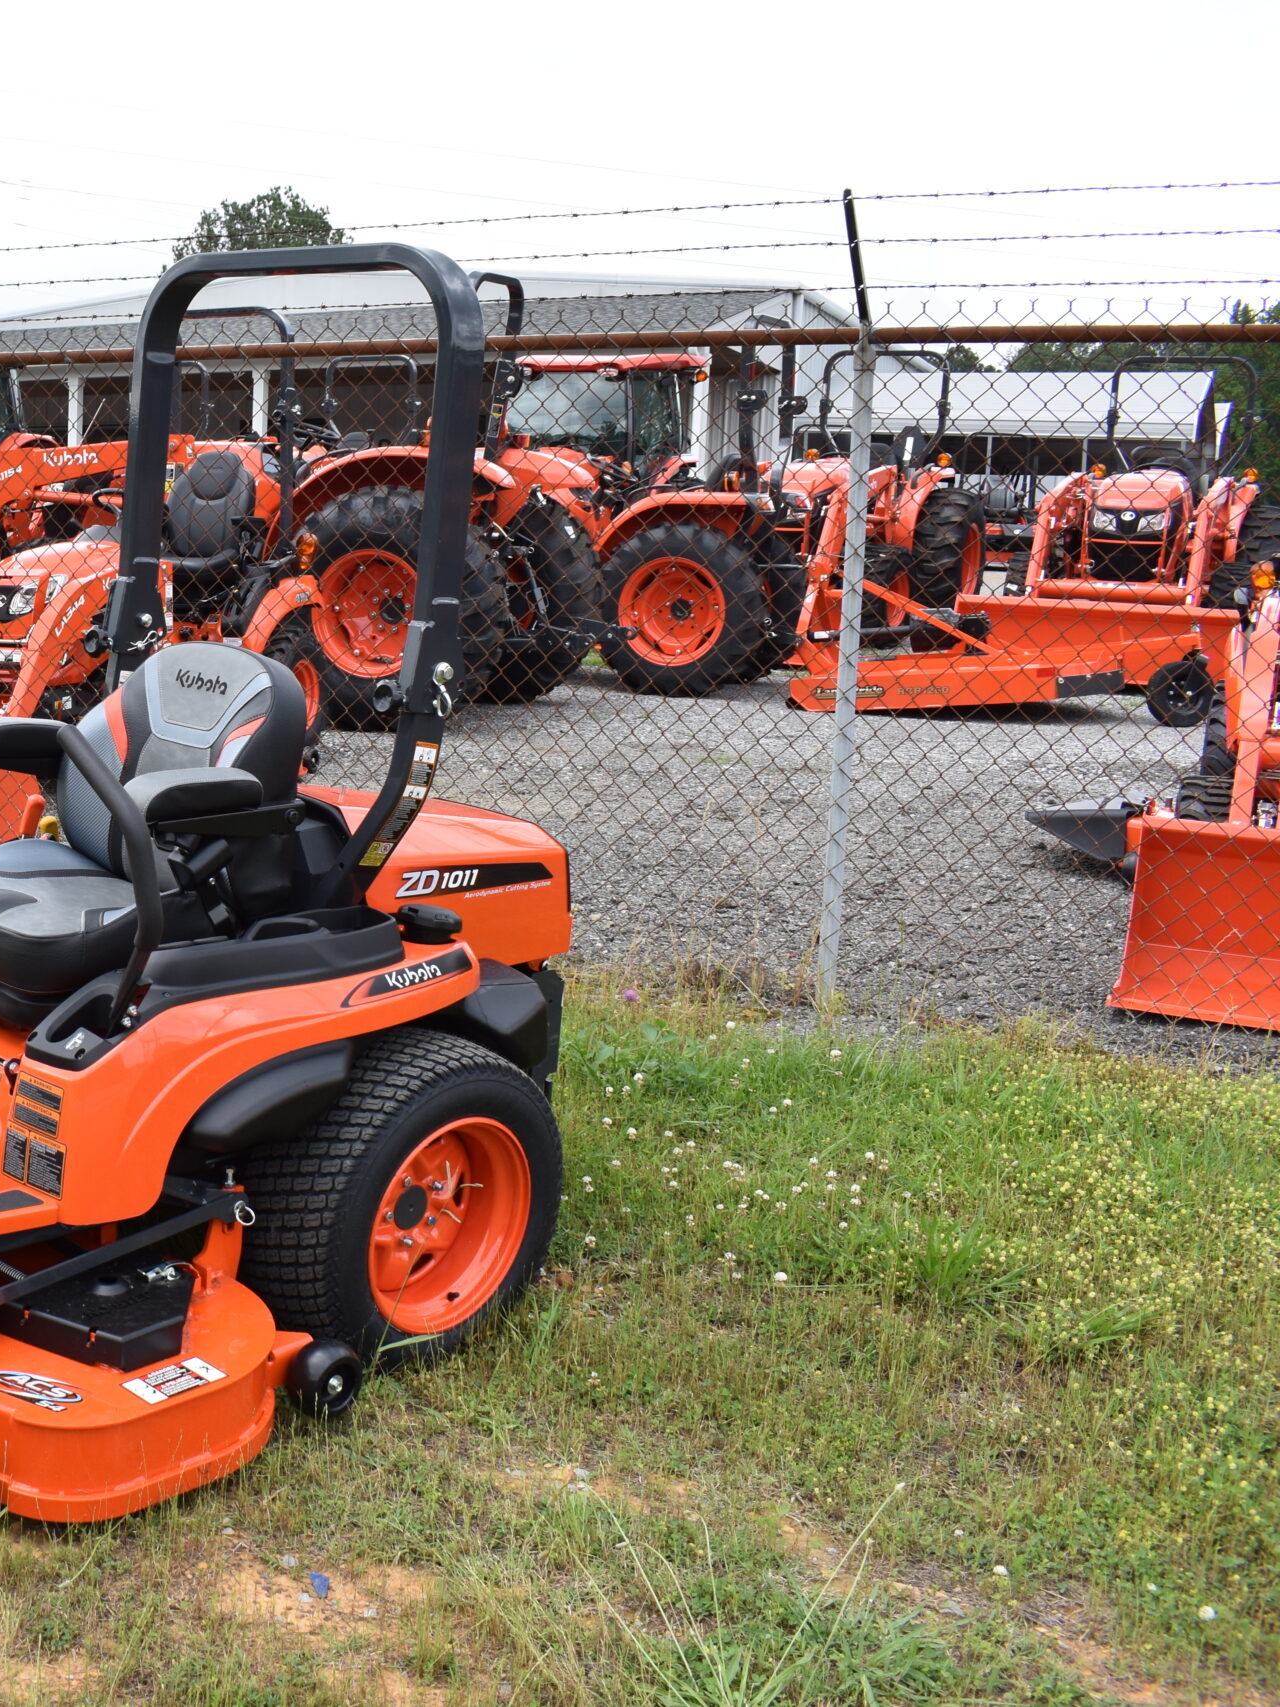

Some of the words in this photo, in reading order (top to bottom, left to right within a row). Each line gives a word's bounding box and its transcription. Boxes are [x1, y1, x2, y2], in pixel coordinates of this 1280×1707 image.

[43, 449, 99, 467] Kubota
[176, 668, 228, 695] Kubota
[395, 869, 440, 898] ZD
[440, 868, 479, 889] 1011
[505, 884, 529, 893] Cutting
[384, 962, 442, 989] Kubota
[3, 1374, 74, 1398] ACS
